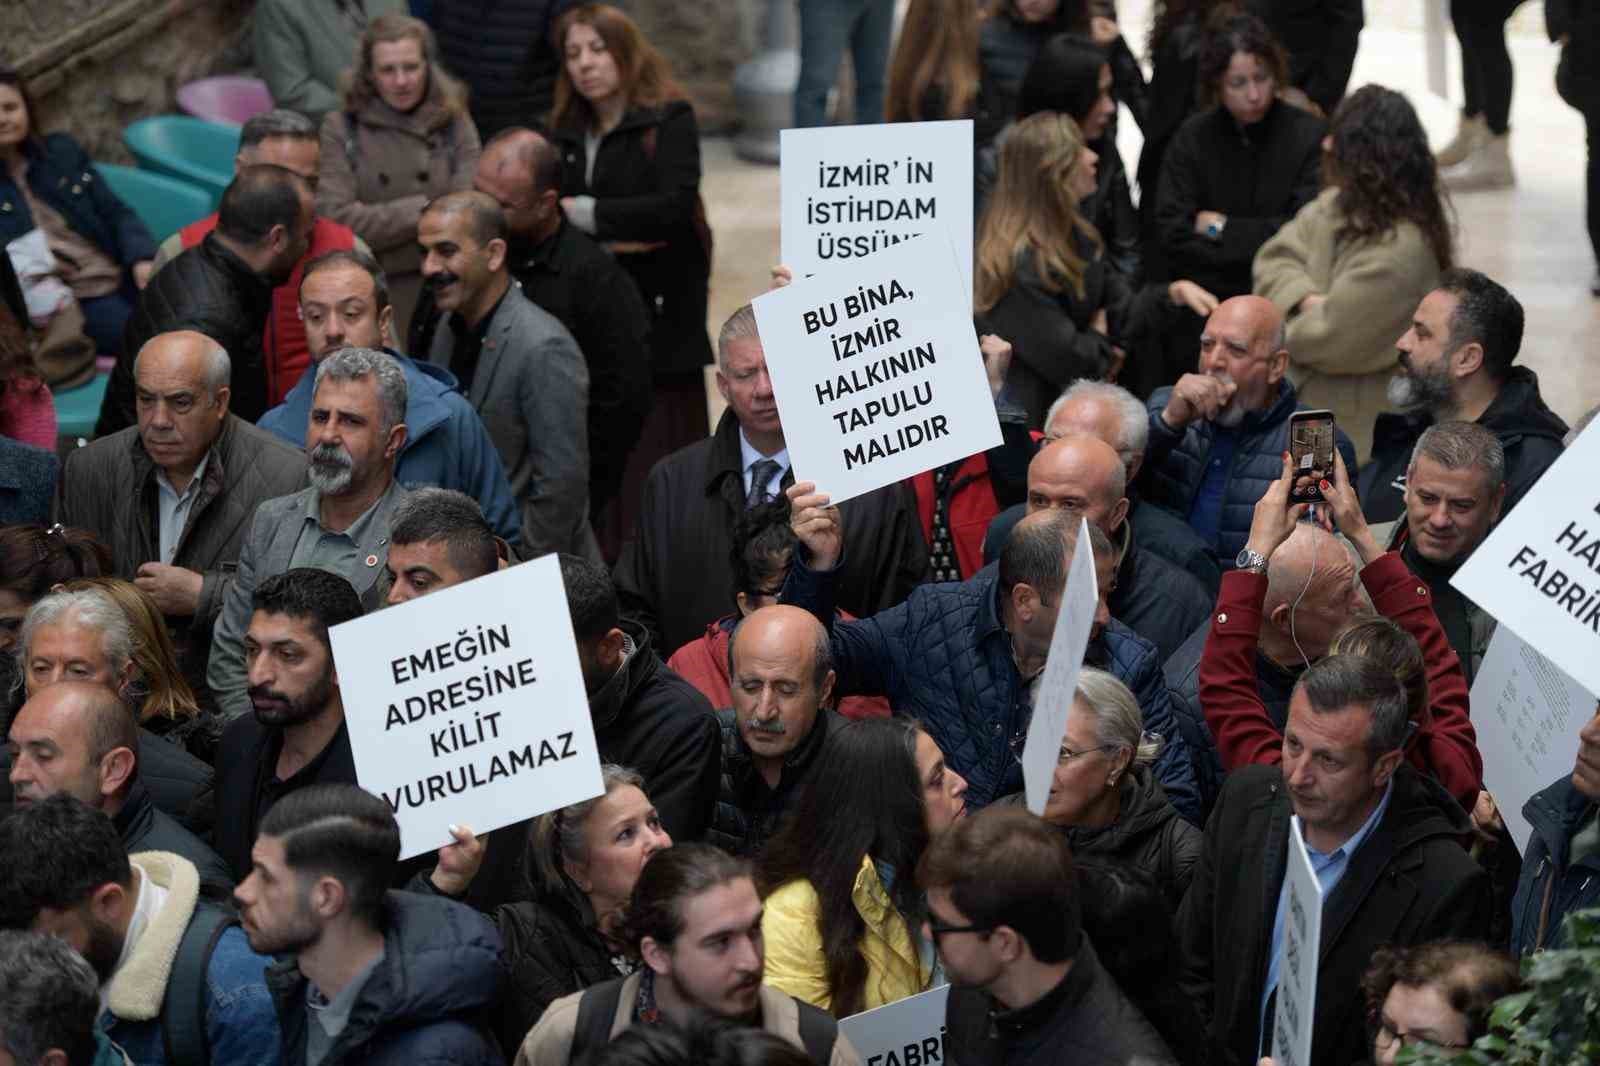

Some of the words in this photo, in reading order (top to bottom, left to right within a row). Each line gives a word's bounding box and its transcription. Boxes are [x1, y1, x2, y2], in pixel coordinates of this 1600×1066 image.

[807, 195, 936, 225] İSTİHDAM
[817, 229, 921, 260] ÜSSÜ
[802, 302, 838, 335] BU
[843, 279, 914, 320] BİNA,
[830, 317, 902, 362] İZMİR
[814, 342, 937, 406] HALKININ
[832, 380, 933, 435] TAPULU
[843, 414, 950, 471] MALIDIR
[1555, 521, 1600, 575] HA
[391, 624, 511, 685] EMEĞİN
[385, 658, 537, 731] ADRESİNE
[429, 711, 501, 758] KİLİT
[381, 731, 577, 814] VURULAMAZ
